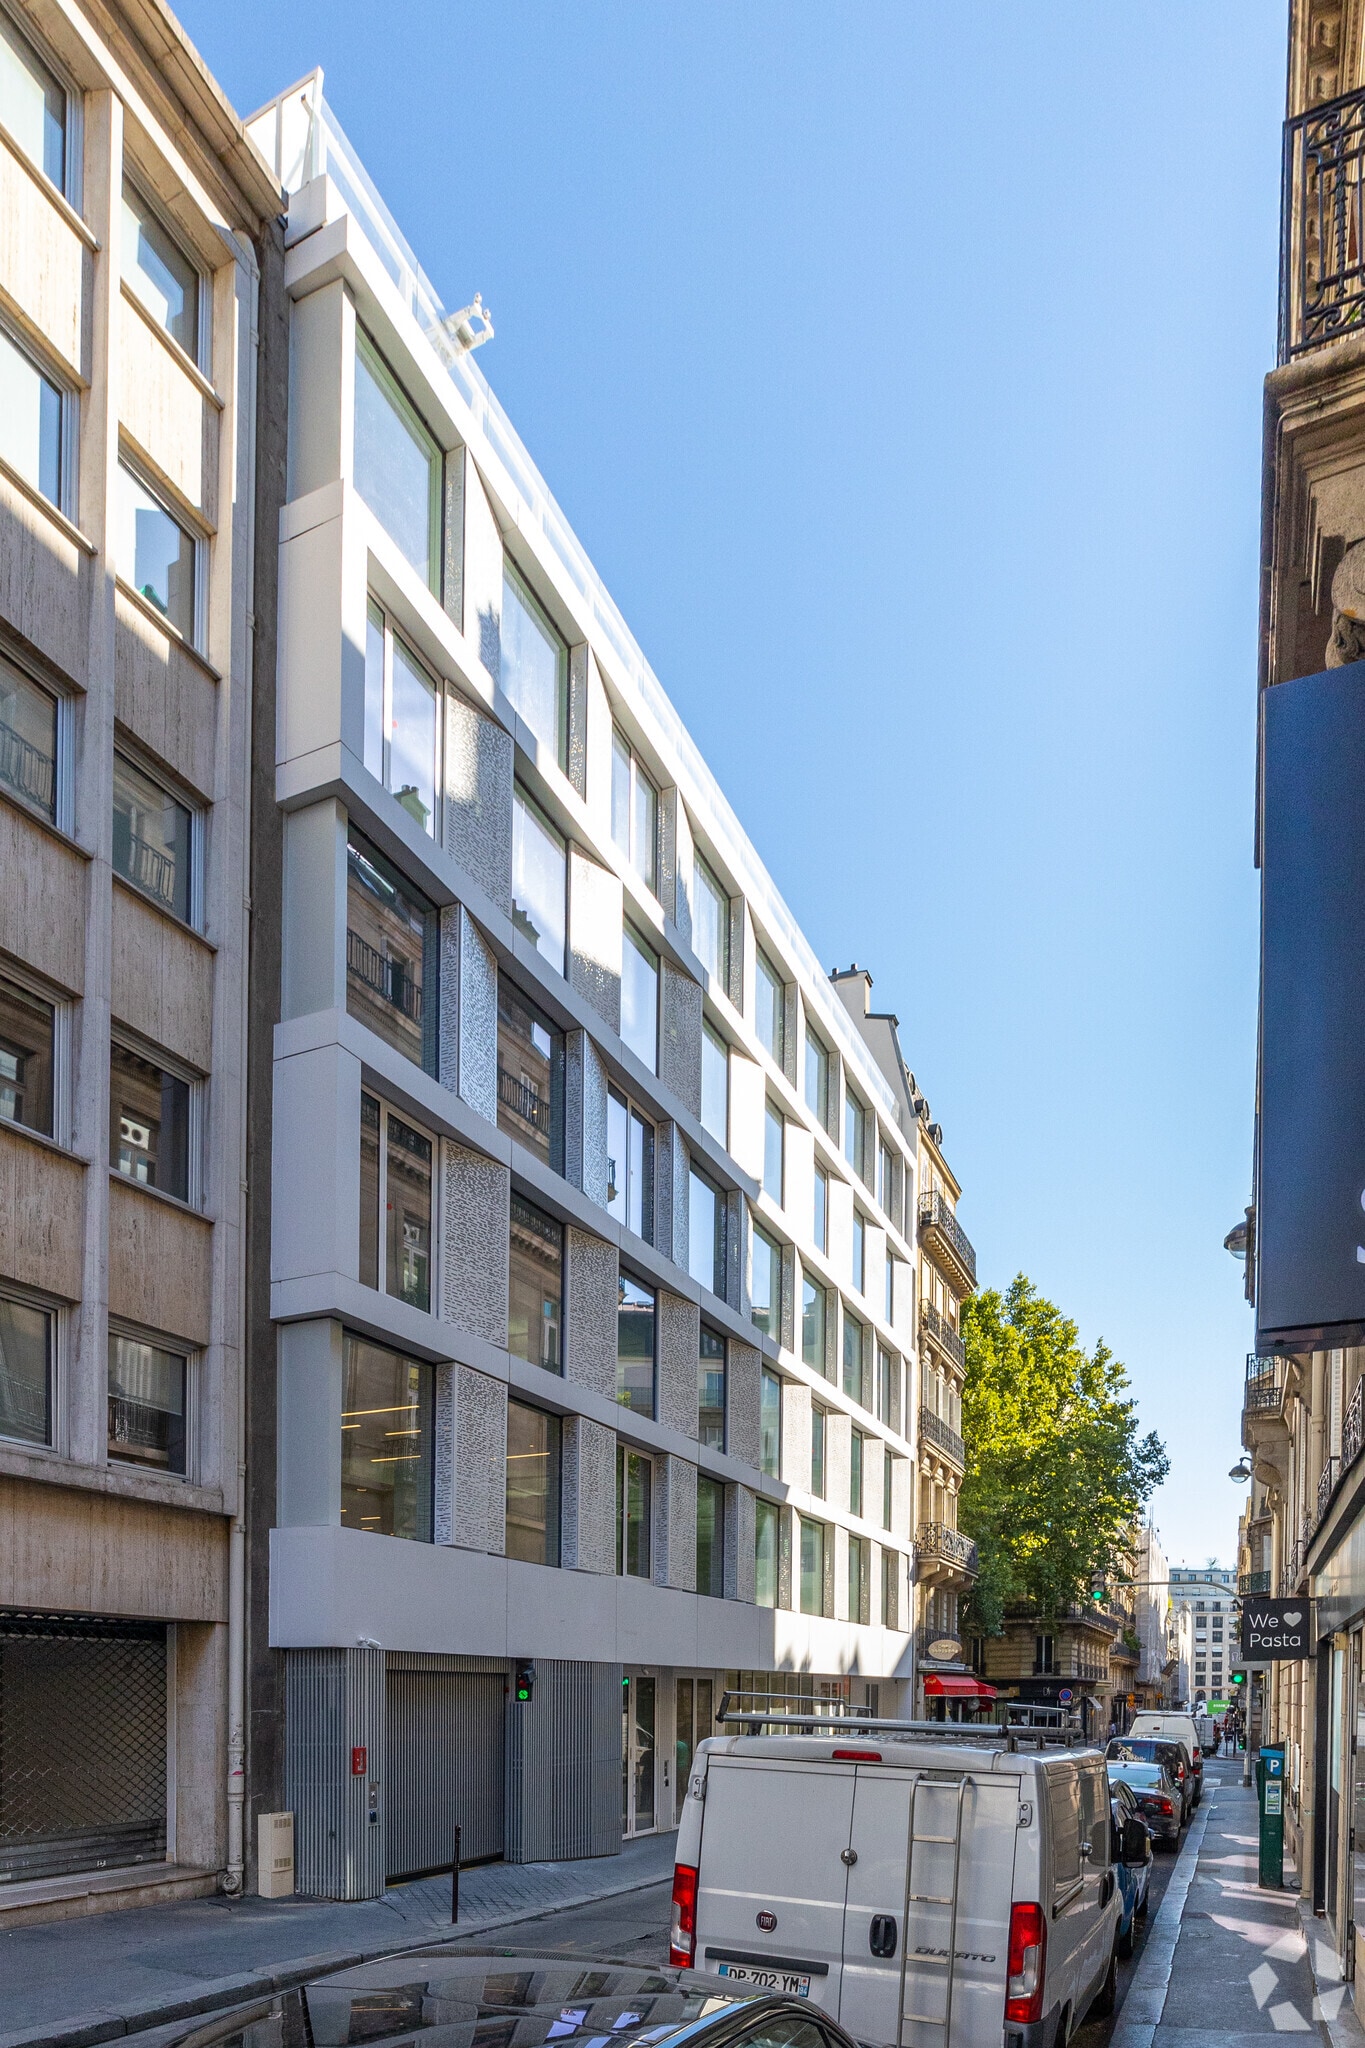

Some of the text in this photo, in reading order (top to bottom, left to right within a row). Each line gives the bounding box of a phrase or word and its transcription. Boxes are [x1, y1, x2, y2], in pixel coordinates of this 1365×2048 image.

[1249, 1613, 1279, 1629] We
[1250, 1633, 1301, 1648] Pasta
[1270, 1759, 1280, 1772] P
[760, 1915, 773, 1927] FIAT
